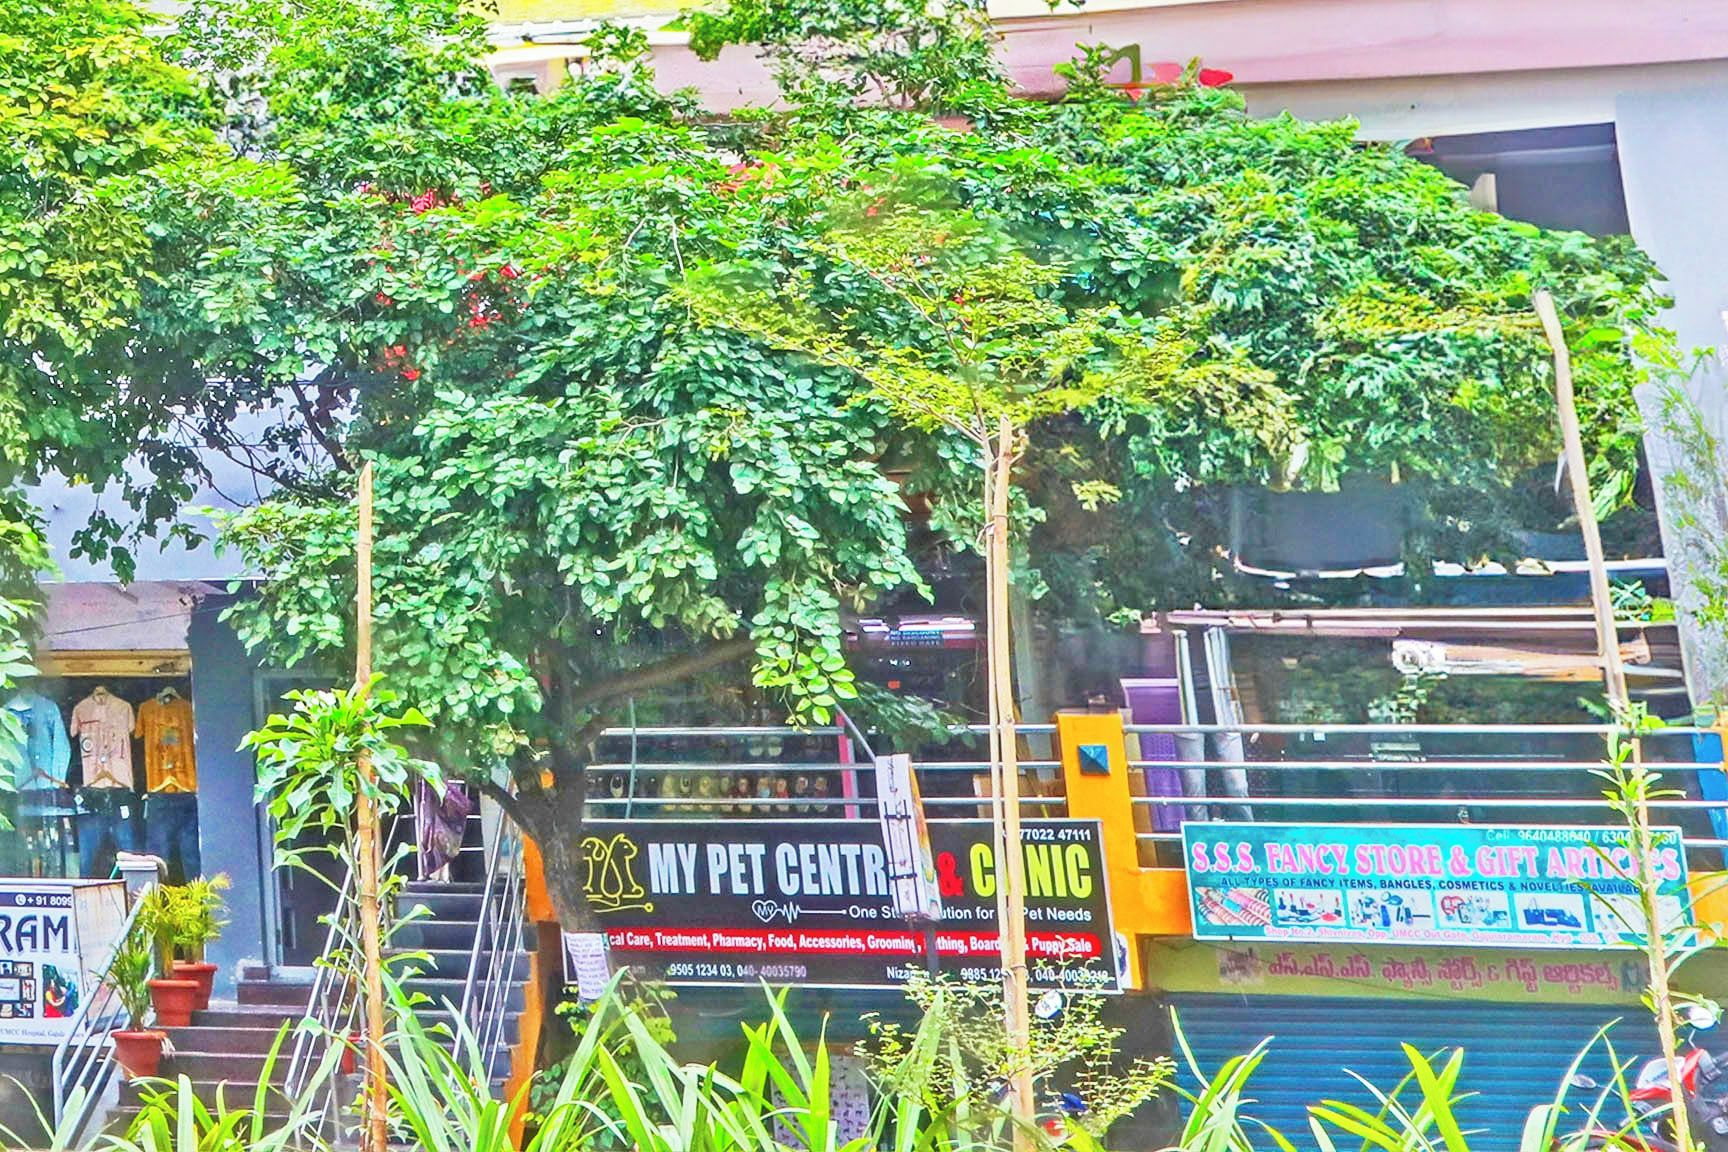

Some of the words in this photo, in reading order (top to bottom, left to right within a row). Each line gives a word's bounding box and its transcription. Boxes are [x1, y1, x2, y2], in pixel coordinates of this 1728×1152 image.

[1057, 829, 1091, 841] 47111
[1192, 842, 1260, 873] S.S.S.
[1264, 843, 1349, 876] FANCY
[1355, 844, 1444, 877] STORE
[1449, 844, 1473, 877] &
[1475, 845, 1539, 878] GIFT
[1547, 847, 1681, 882] ARTICES
[648, 843, 697, 894] MY
[706, 843, 765, 895] PET
[775, 842, 893, 896] CENTR
[937, 851, 964, 897] &
[970, 843, 1093, 899] CNIC
[1222, 878, 1241, 887] ALL
[1245, 878, 1278, 887] TYPES
[1283, 878, 1296, 887] OF
[1300, 879, 1335, 888] FANCY
[1339, 879, 1377, 890] ITEMS,
[1380, 880, 1436, 890] BANGLES,
[1439, 880, 1504, 891] COSMETICS
[1509, 882, 1516, 891] &
[1591, 882, 1639, 893] AVAILA
[36, 895, 48, 905] 91
[757, 905, 774, 916] MY
[849, 906, 877, 919] One
[881, 905, 903, 919] St
[975, 906, 995, 919] for
[1046, 907, 1092, 921] Needs
[626, 933, 653, 949] Care,
[655, 934, 711, 950] Treatment,
[712, 935, 767, 951] Pharmacy,
[768, 935, 797, 951] Food,
[799, 935, 866, 952] Accessories,
[924, 936, 968, 954] thing,
[969, 936, 1001, 951] Board
[1031, 936, 1066, 955] Puppy
[670, 964, 693, 976] 9505
[696, 964, 718, 977] 1234
